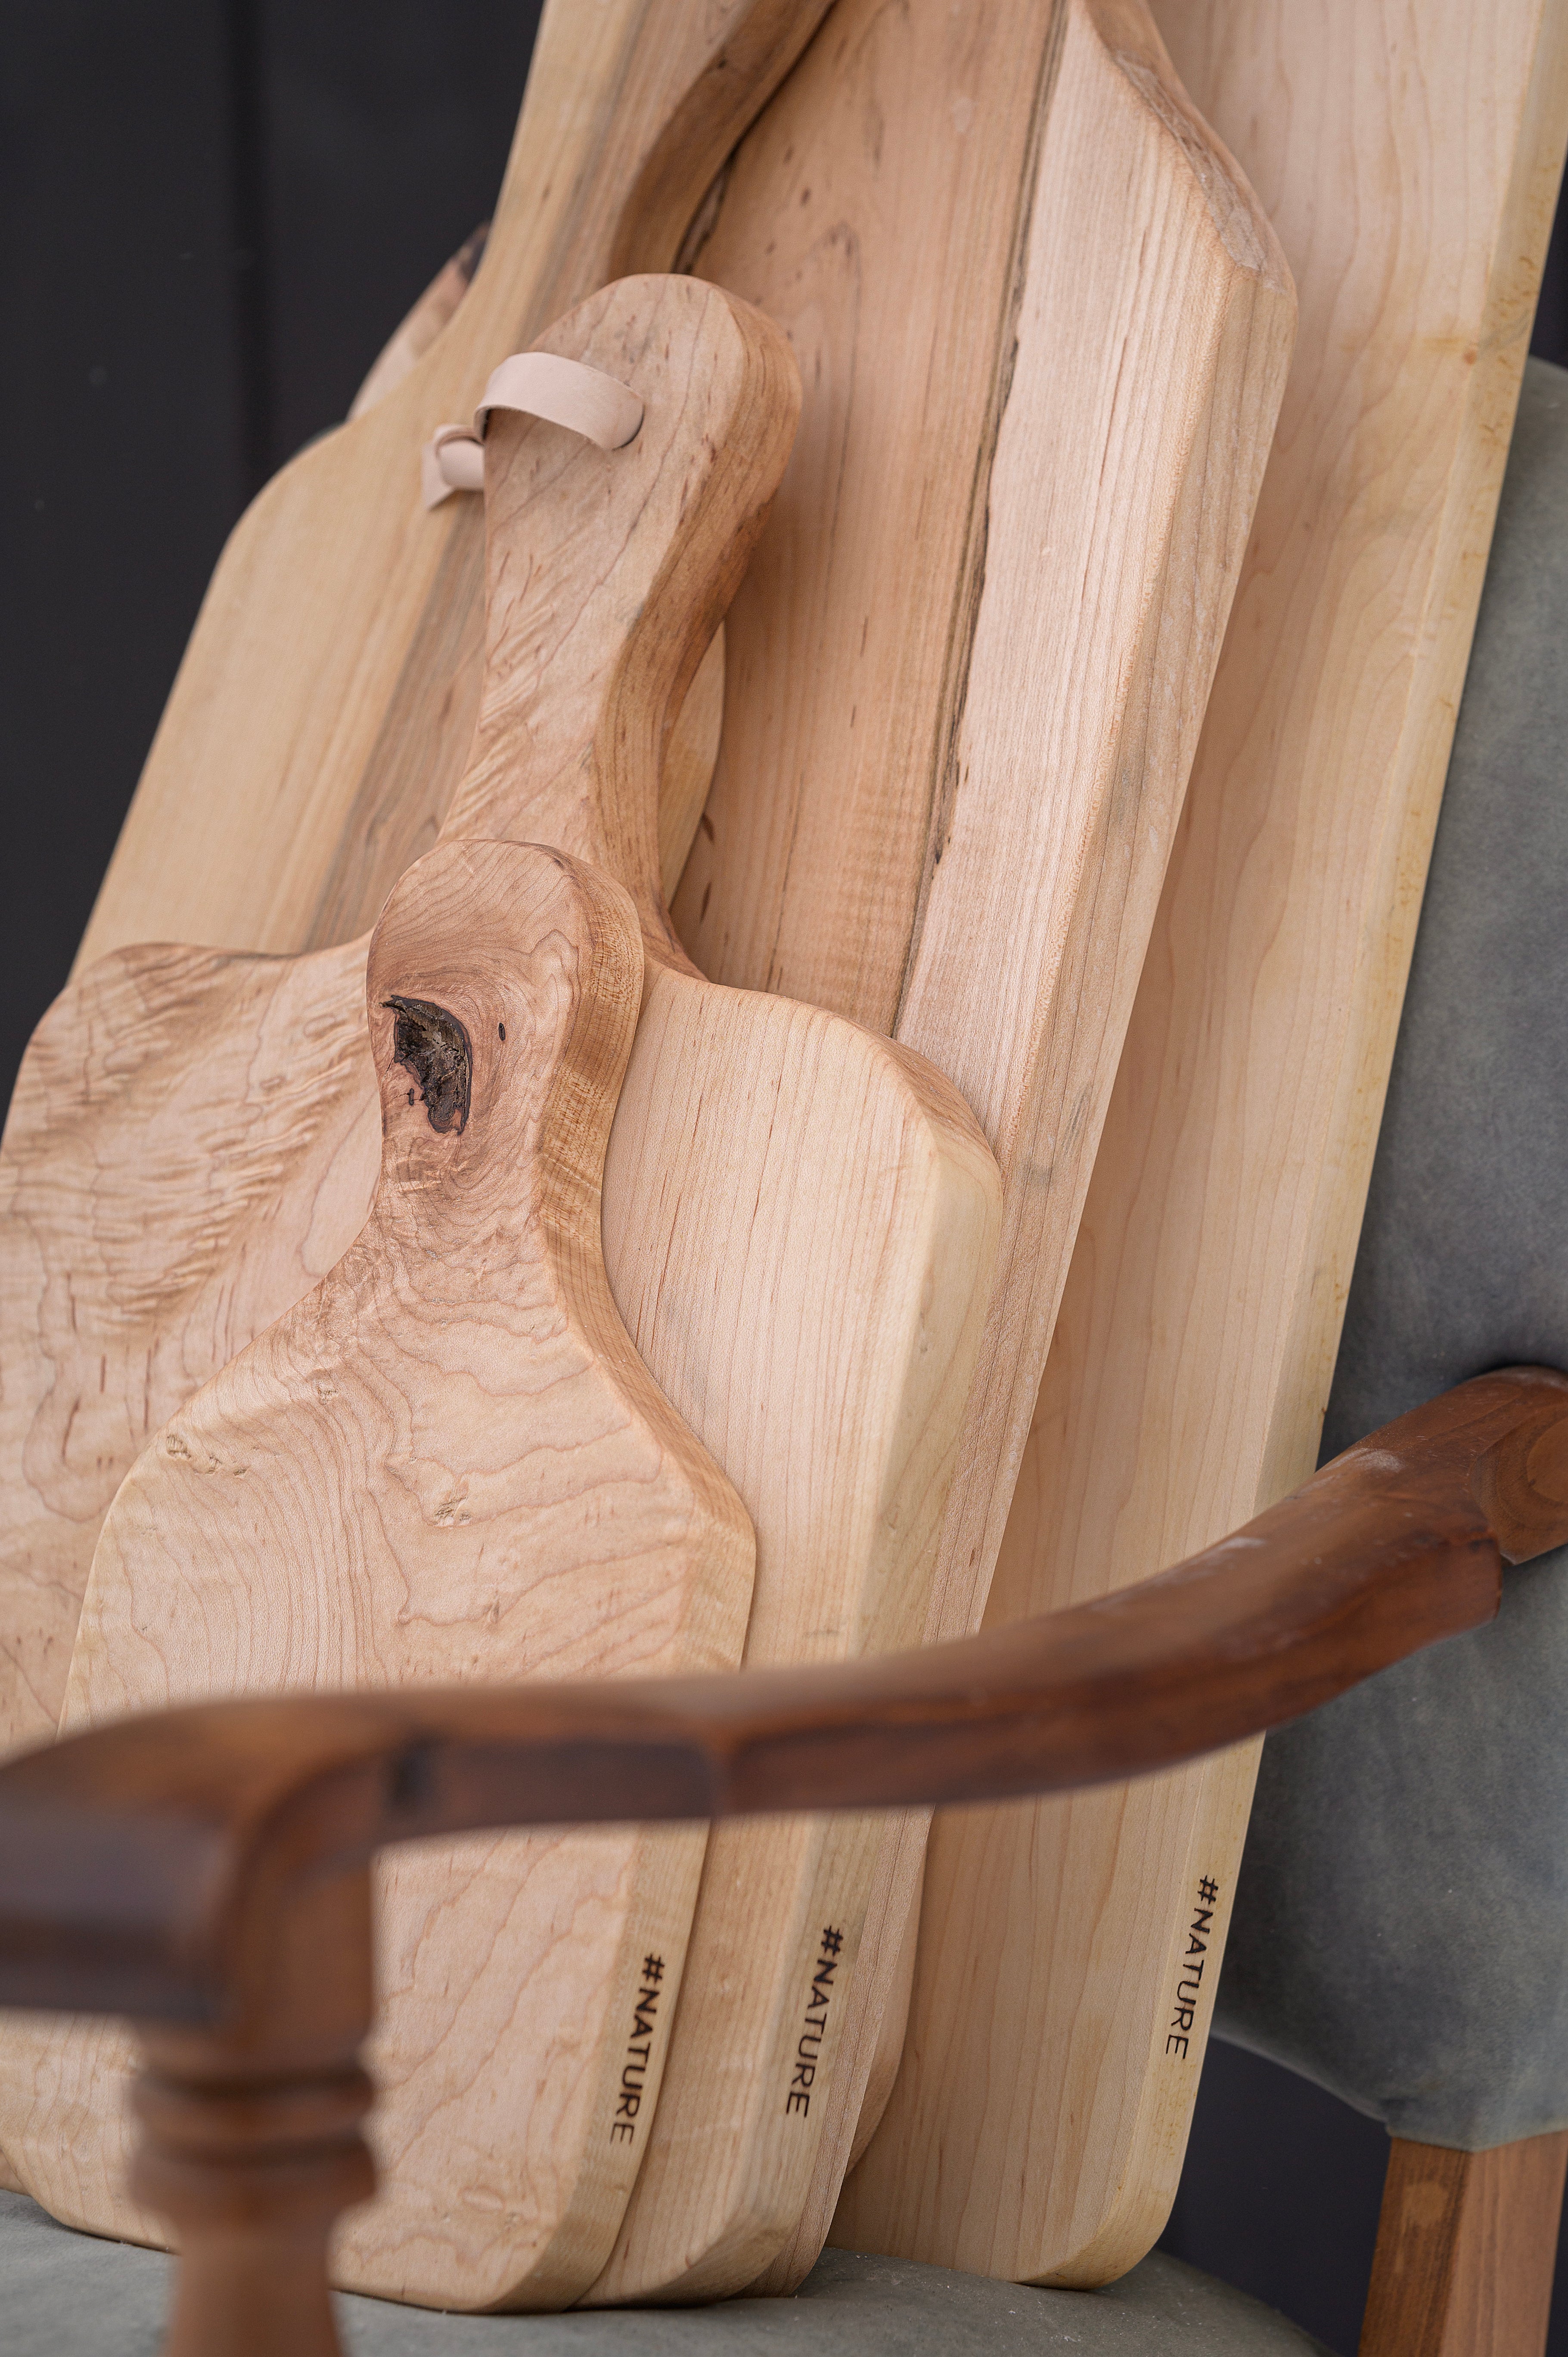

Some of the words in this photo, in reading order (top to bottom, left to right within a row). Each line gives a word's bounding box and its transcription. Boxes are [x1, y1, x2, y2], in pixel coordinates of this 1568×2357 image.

[610, 1953, 665, 2146] #NATURE
[786, 1925, 844, 2118] #NATURE
[1165, 1875, 1218, 2059] #NATURE
